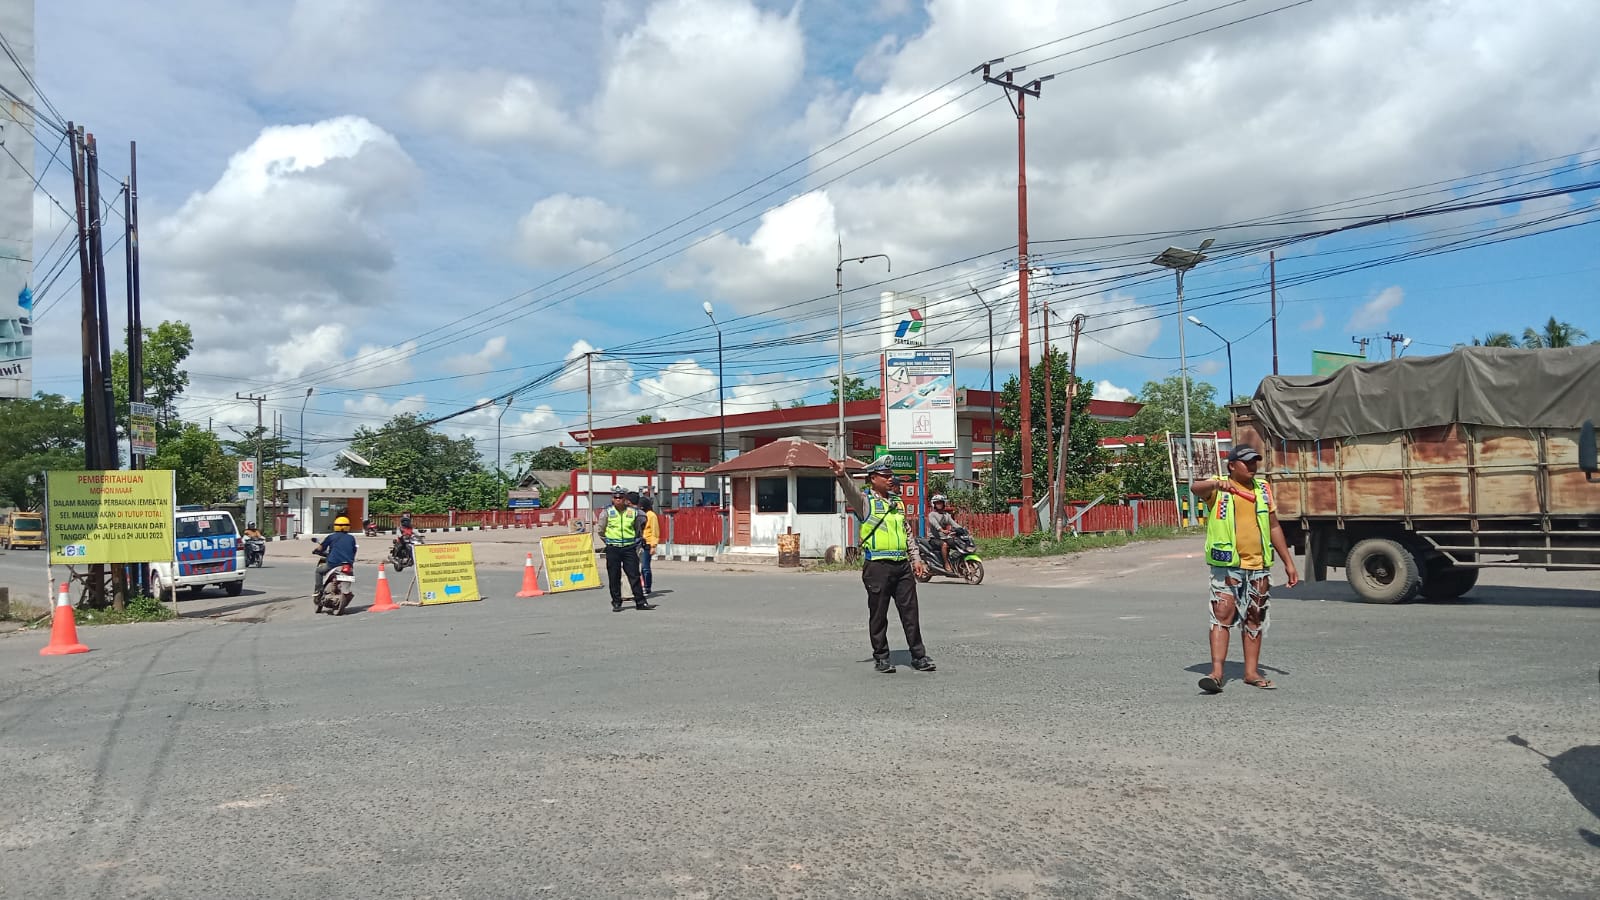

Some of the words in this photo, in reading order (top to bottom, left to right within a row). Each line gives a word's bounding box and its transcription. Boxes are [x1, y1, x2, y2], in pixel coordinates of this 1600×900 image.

[894, 338, 923, 347] PERTAMINA
[78, 475, 144, 484] PEMBERITAHUAN
[53, 499, 77, 507] DALAM
[77, 499, 102, 507] RANGKA
[103, 499, 136, 507] PERBAIKAN
[137, 498, 168, 507] JEMBATAN
[72, 511, 98, 519] MALUKA
[117, 510, 124, 518] DI
[125, 510, 144, 518] TUTUP
[144, 510, 162, 518] TOTAL
[55, 524, 85, 532] SELAMA
[86, 523, 109, 531] MASA
[109, 523, 148, 531] PERBAIKAN
[149, 522, 166, 530] DARI
[102, 533, 117, 541] JULI
[135, 532, 149, 541] JULI
[177, 537, 236, 553] POLISI
